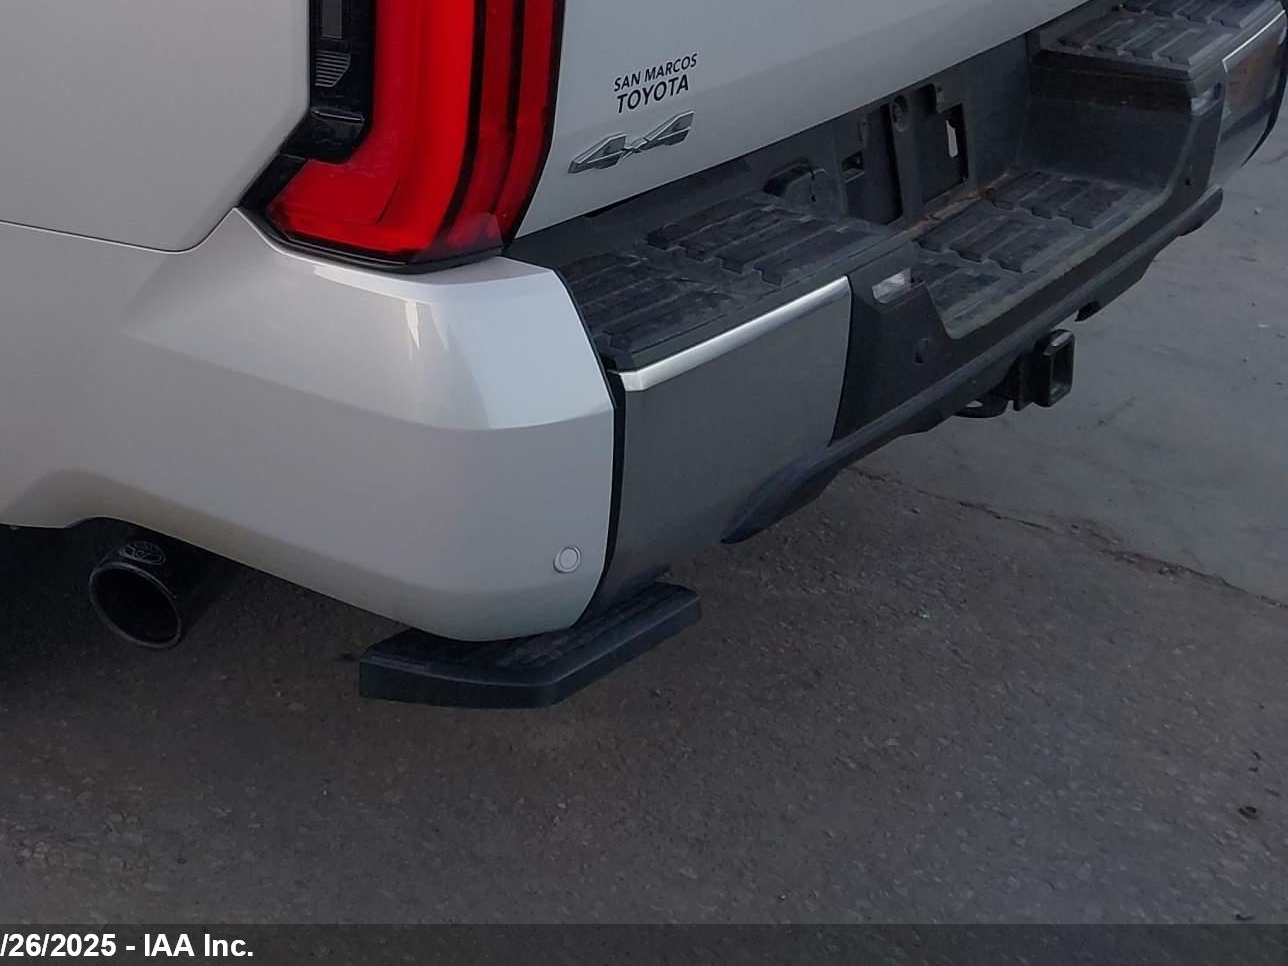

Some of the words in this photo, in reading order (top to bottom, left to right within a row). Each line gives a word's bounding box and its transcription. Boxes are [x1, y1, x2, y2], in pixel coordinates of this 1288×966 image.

[613, 71, 641, 92] SAN
[644, 53, 697, 83] MARCOS
[616, 73, 689, 114] TOYOTA
